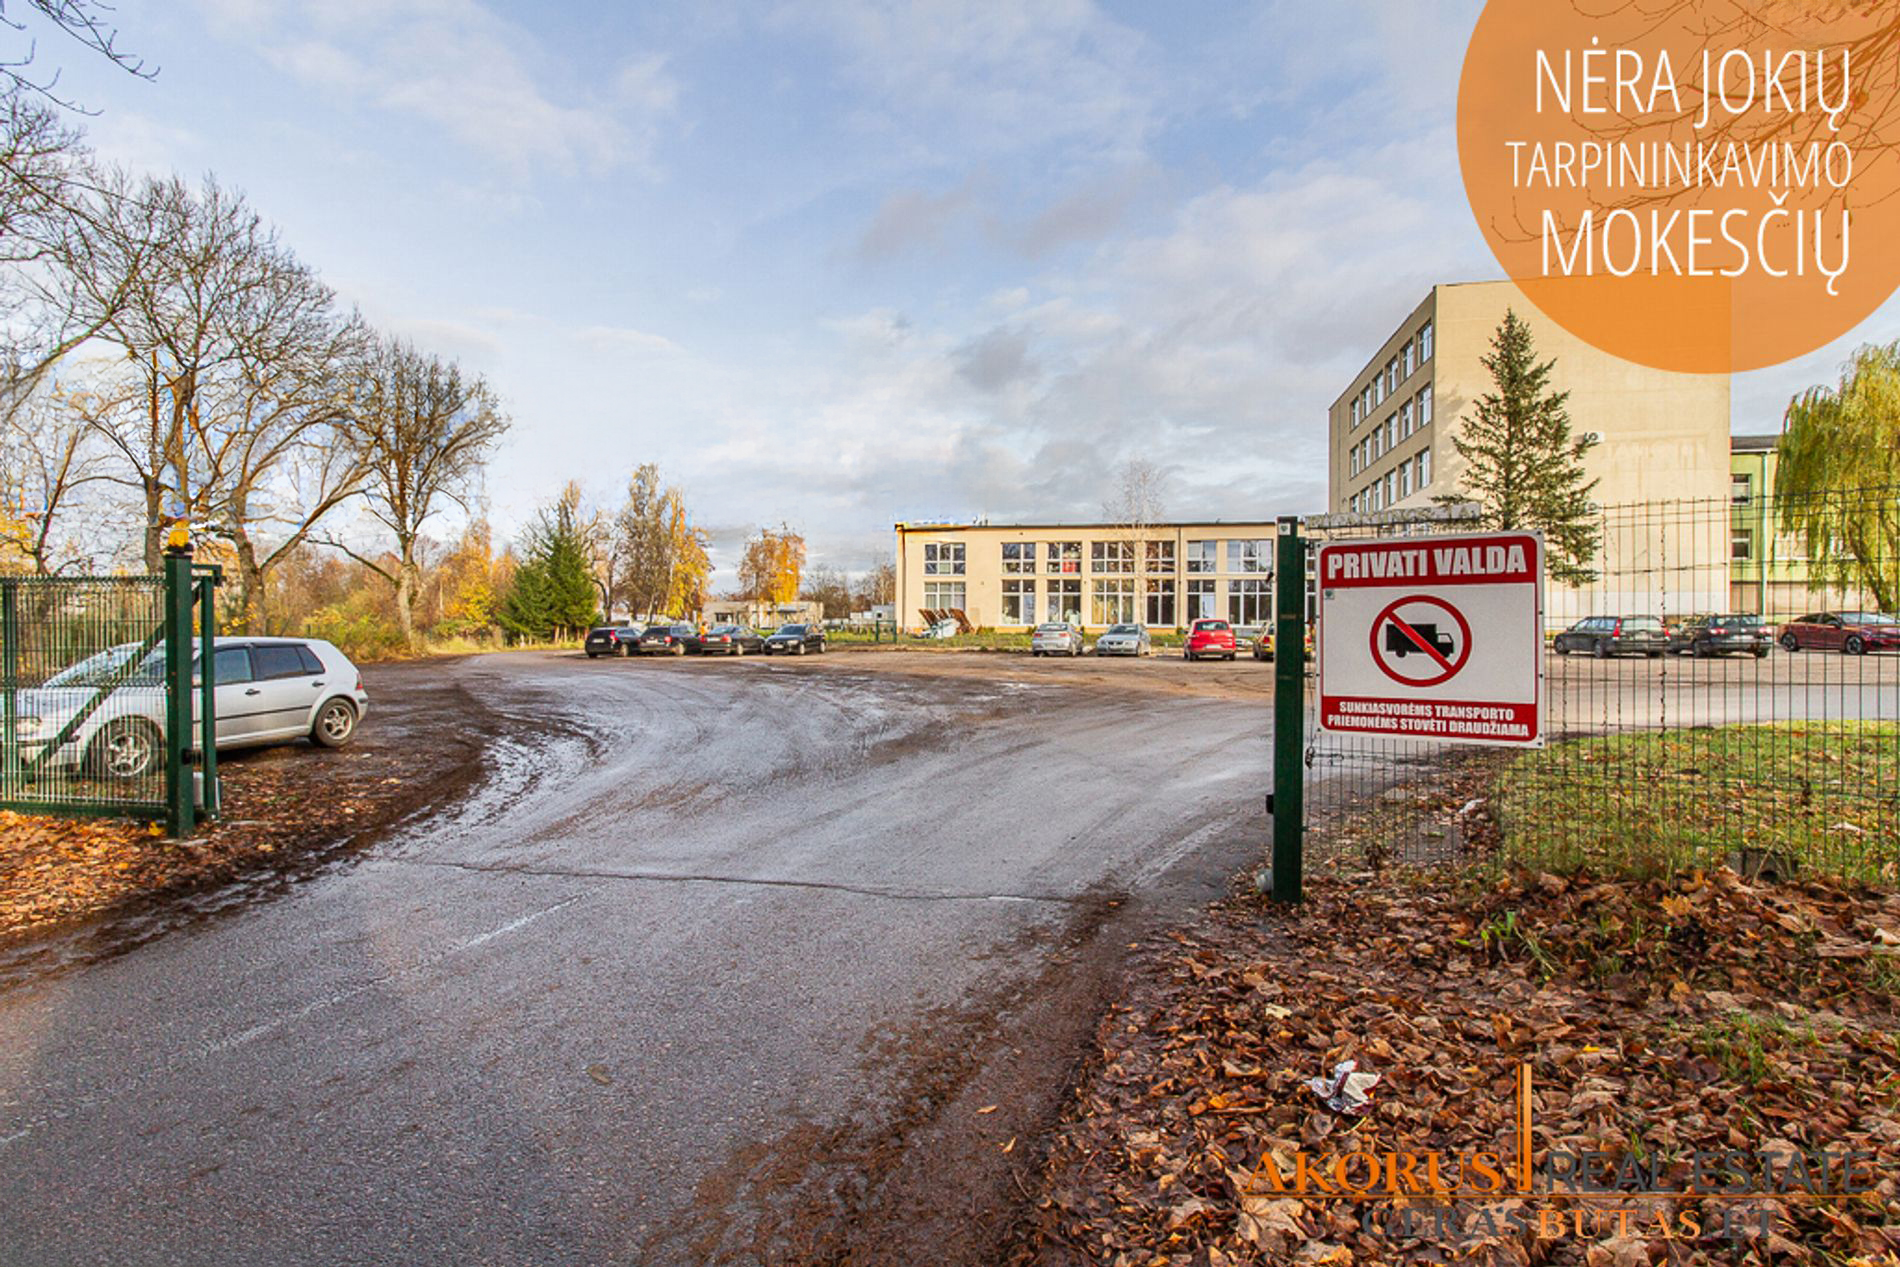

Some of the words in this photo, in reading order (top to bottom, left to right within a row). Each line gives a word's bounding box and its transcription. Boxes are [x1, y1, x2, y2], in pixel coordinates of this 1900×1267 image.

[1327, 549, 1428, 580] PRIVATI
[1433, 545, 1526, 576] VALDA
[1435, 705, 1515, 721] TRANSPORTO
[1400, 717, 1447, 732] STOVĖTI
[1449, 720, 1530, 737] DRAUDŽIAMA
